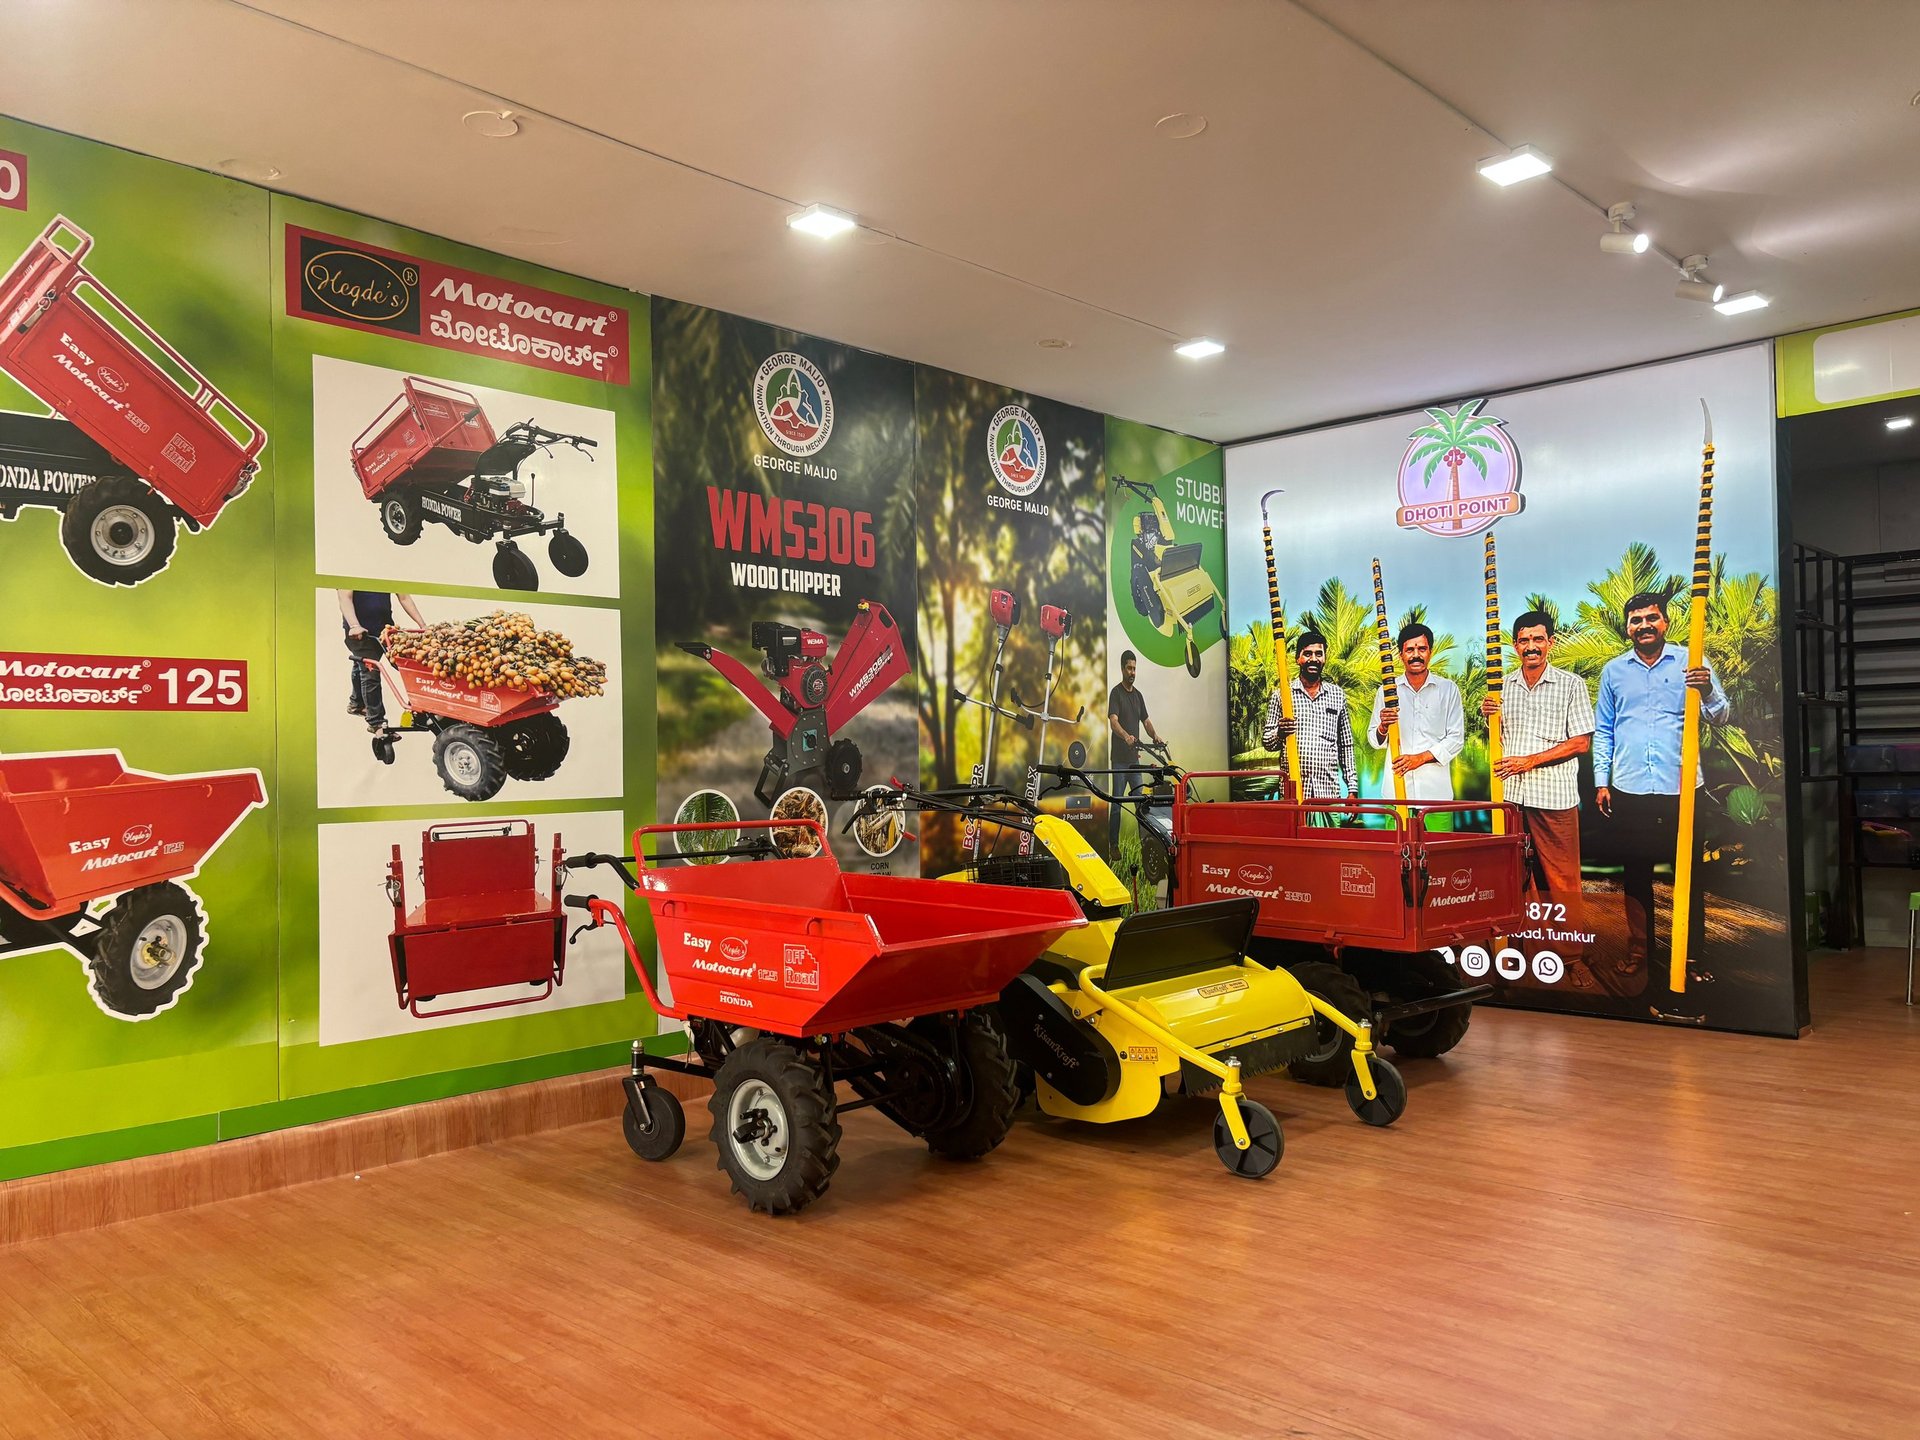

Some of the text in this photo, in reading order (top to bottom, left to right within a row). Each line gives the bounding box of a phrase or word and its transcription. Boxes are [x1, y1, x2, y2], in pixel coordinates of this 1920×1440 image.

[310, 264, 405, 308] Hegde's
[59, 332, 95, 366] Easy
[761, 353, 825, 388] GEORGE MAIJO
[756, 383, 832, 453] INNOVATION THROUGH MECHANIZATION
[993, 406, 1040, 436] GEORGE MAIJO
[753, 454, 838, 481] GEORGE MAIJO
[989, 433, 1045, 493] INNOVATION THROUGH MECHANIZATION
[0, 464, 41, 491] ONDA
[441, 503, 462, 522] POWER
[986, 494, 1049, 516] GEORGE MAIJO
[1404, 497, 1510, 522] DHOTI POINT
[706, 485, 876, 568] WMS306
[730, 562, 842, 597] WOOD CHIPPER
[158, 667, 243, 706] 125
[848, 656, 883, 698] WMS306
[1024, 765, 1039, 802] DLX
[1079, 812, 1094, 820] Blade
[69, 837, 111, 854] Easy
[80, 845, 159, 872] Motocart
[870, 862, 890, 871] CORN
[1201, 863, 1231, 878] Easy
[1341, 866, 1362, 879] OFF
[1204, 883, 1312, 903] Motocart 350
[1341, 880, 1375, 894] Road
[1429, 892, 1476, 908] Motocart
[1525, 902, 1567, 922] 872
[683, 932, 712, 952] Easy
[1546, 928, 1596, 943] Tumkur
[785, 948, 805, 965] OFF
[692, 959, 754, 978] Motocart
[785, 966, 818, 986] Road
[719, 995, 754, 1008] HONDA
